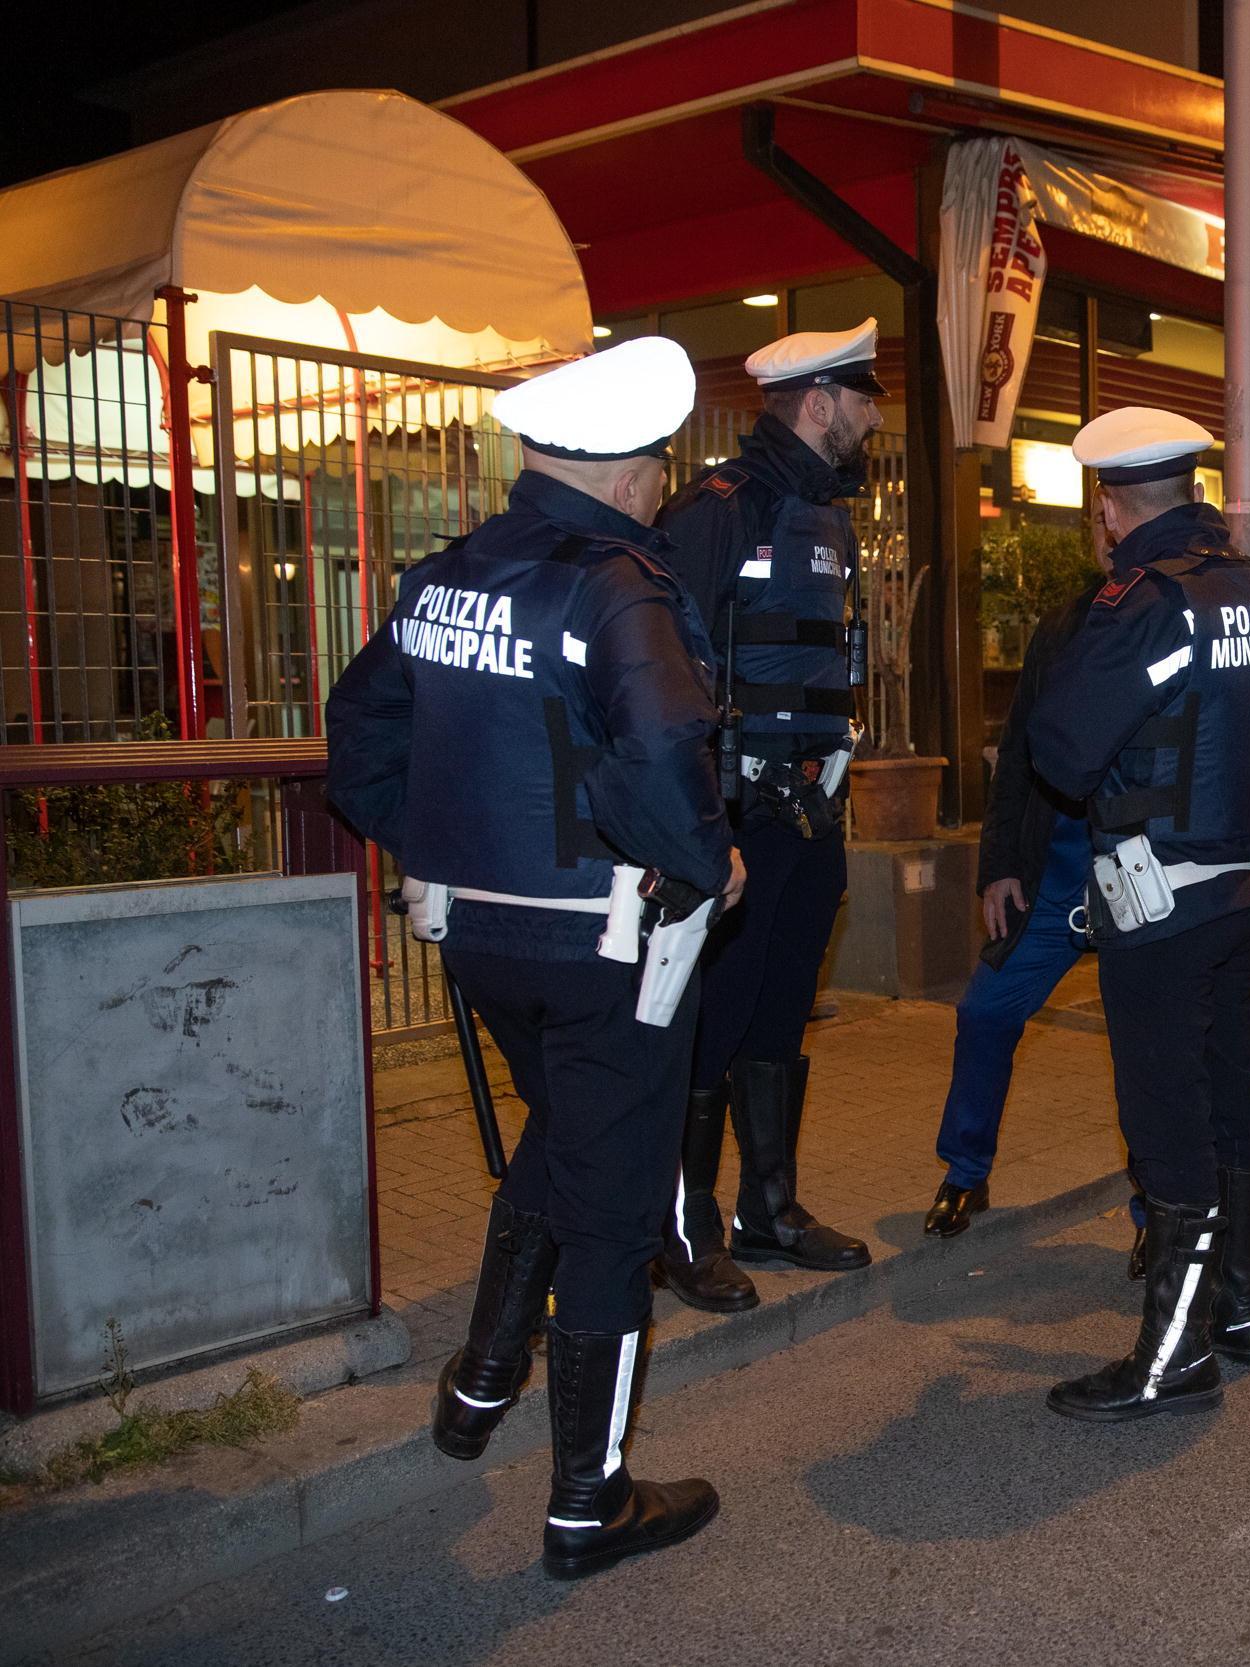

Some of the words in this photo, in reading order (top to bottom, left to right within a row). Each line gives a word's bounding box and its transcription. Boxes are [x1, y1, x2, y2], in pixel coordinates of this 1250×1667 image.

[981, 387, 993, 418] NEW
[990, 314, 1006, 350] YORK
[413, 584, 512, 635] POLIZIA
[401, 617, 534, 679] MUNICIPALE
